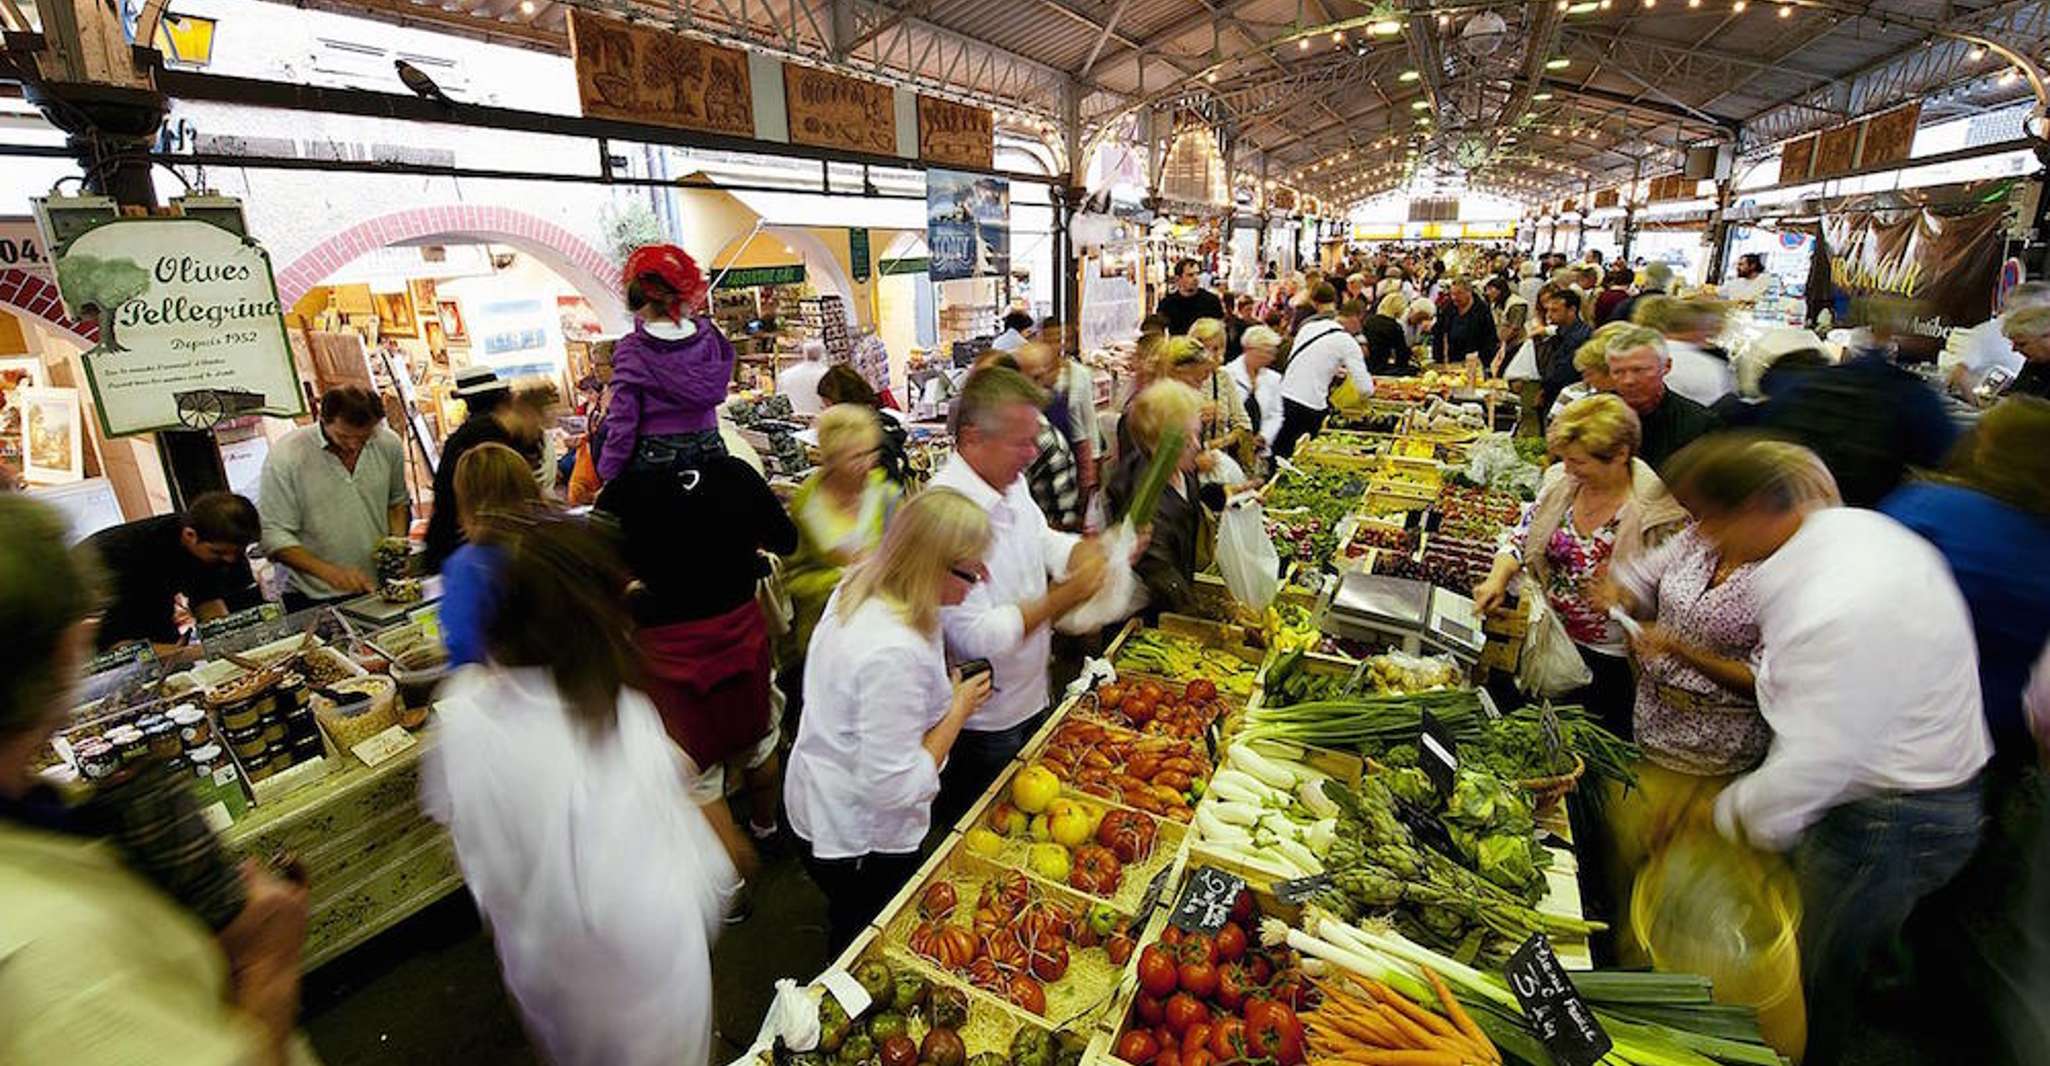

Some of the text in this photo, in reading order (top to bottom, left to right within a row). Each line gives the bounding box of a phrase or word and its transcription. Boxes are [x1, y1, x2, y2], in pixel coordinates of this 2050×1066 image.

[154, 256, 251, 284] Olives
[170, 331, 258, 352] Depuis 1952
